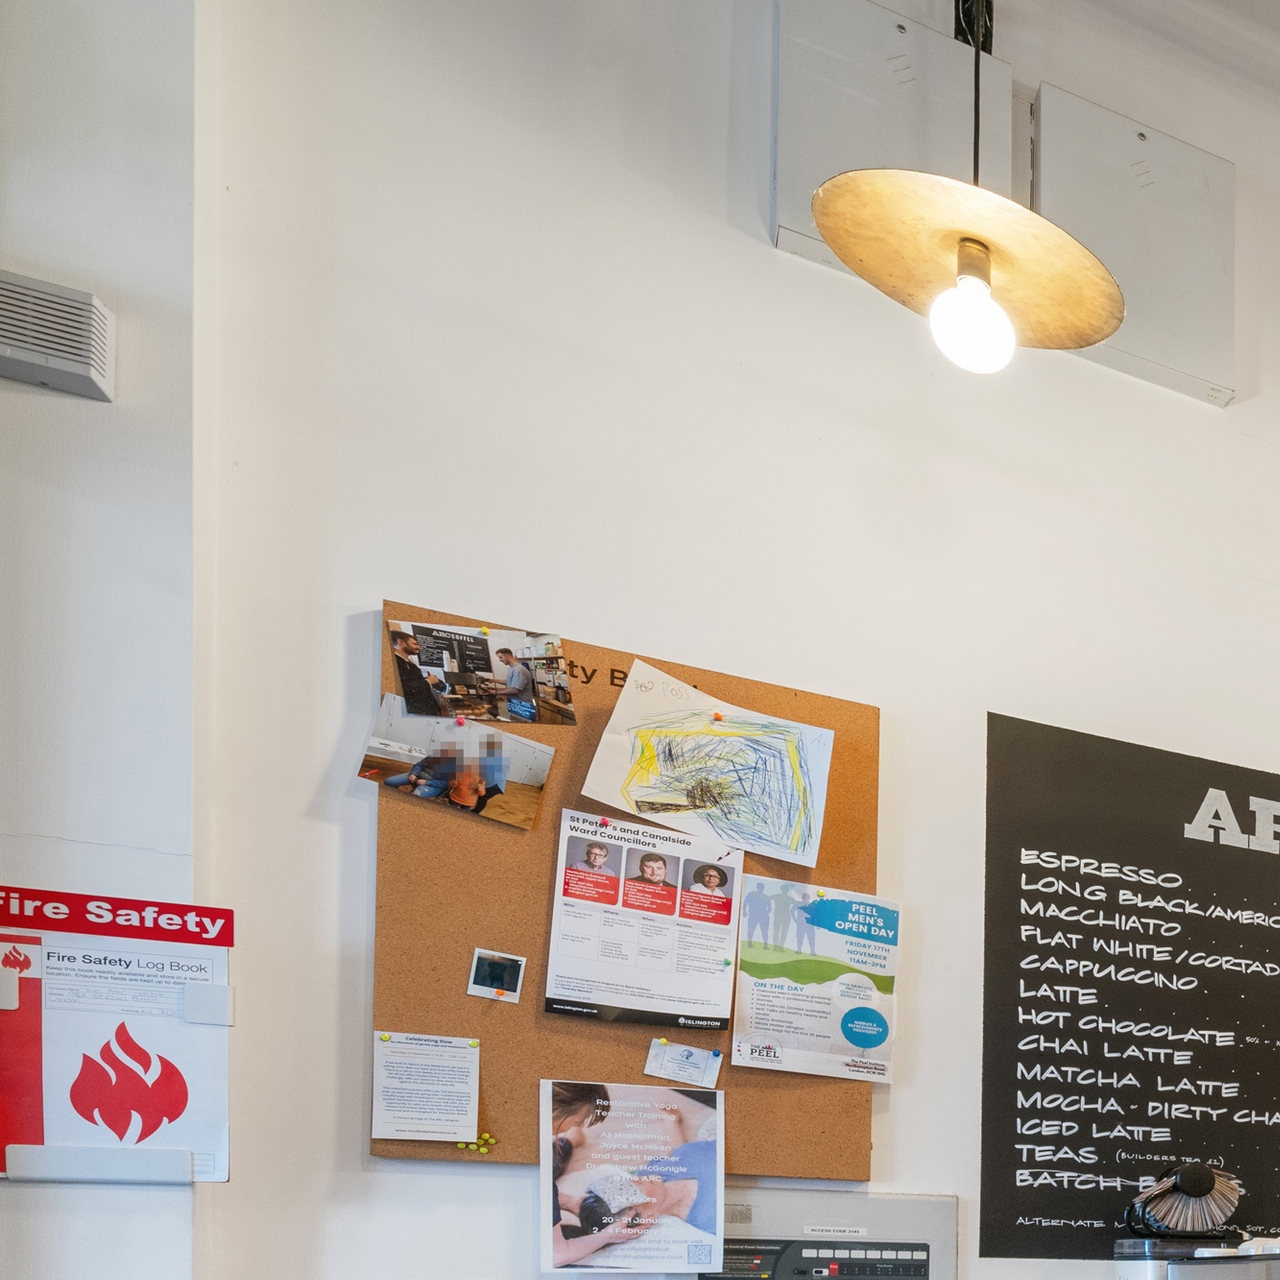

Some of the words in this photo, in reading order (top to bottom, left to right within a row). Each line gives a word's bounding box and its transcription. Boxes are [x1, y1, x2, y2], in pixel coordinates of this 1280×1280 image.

[569, 825, 597, 837] Ward
[600, 831, 657, 848] Councillors
[620, 826, 639, 836] and
[642, 831, 691, 846] Canalside
[1020, 848, 1183, 887] ESPRESSO
[1021, 874, 1107, 901] LONG
[86, 901, 225, 939] Safety
[848, 913, 884, 926] MEN'S
[852, 904, 877, 916] PEEL
[1020, 899, 1181, 936] MACCHIATO
[835, 921, 868, 934] OPEN
[871, 928, 895, 939] DAY
[1020, 926, 1082, 949] FLAT
[845, 940, 872, 950] FRIDAY
[874, 945, 890, 953] 17TH
[847, 949, 887, 961] NOVEMBER
[47, 952, 76, 963] Fire
[82, 954, 132, 969] Safety
[137, 959, 165, 972] Log
[170, 961, 208, 973] Book
[1020, 955, 1198, 990] CAPPUCCINO
[1020, 979, 1098, 1004] LATTE
[1017, 1006, 1071, 1029] HOT
[1078, 1015, 1235, 1047] CHOCOLATE
[750, 1049, 779, 1059] PEEL
[1017, 1035, 1088, 1054] CHAI
[1104, 1042, 1193, 1065] LATTE
[1017, 1062, 1140, 1088] MATCHA
[1157, 1076, 1240, 1097] LATTE
[638, 1112, 676, 1121] Training
[653, 1102, 677, 1110] Yoga
[1017, 1091, 1125, 1115] MOCHA
[1148, 1102, 1227, 1121] DIRTY
[625, 1121, 647, 1129] with
[1016, 1118, 1079, 1135] ICED
[1093, 1123, 1171, 1141] LATTE
[613, 1153, 641, 1161] guest
[643, 1154, 680, 1162] teacher
[1015, 1144, 1098, 1163] TEAS
[1016, 1217, 1105, 1228] ALTERNATE
